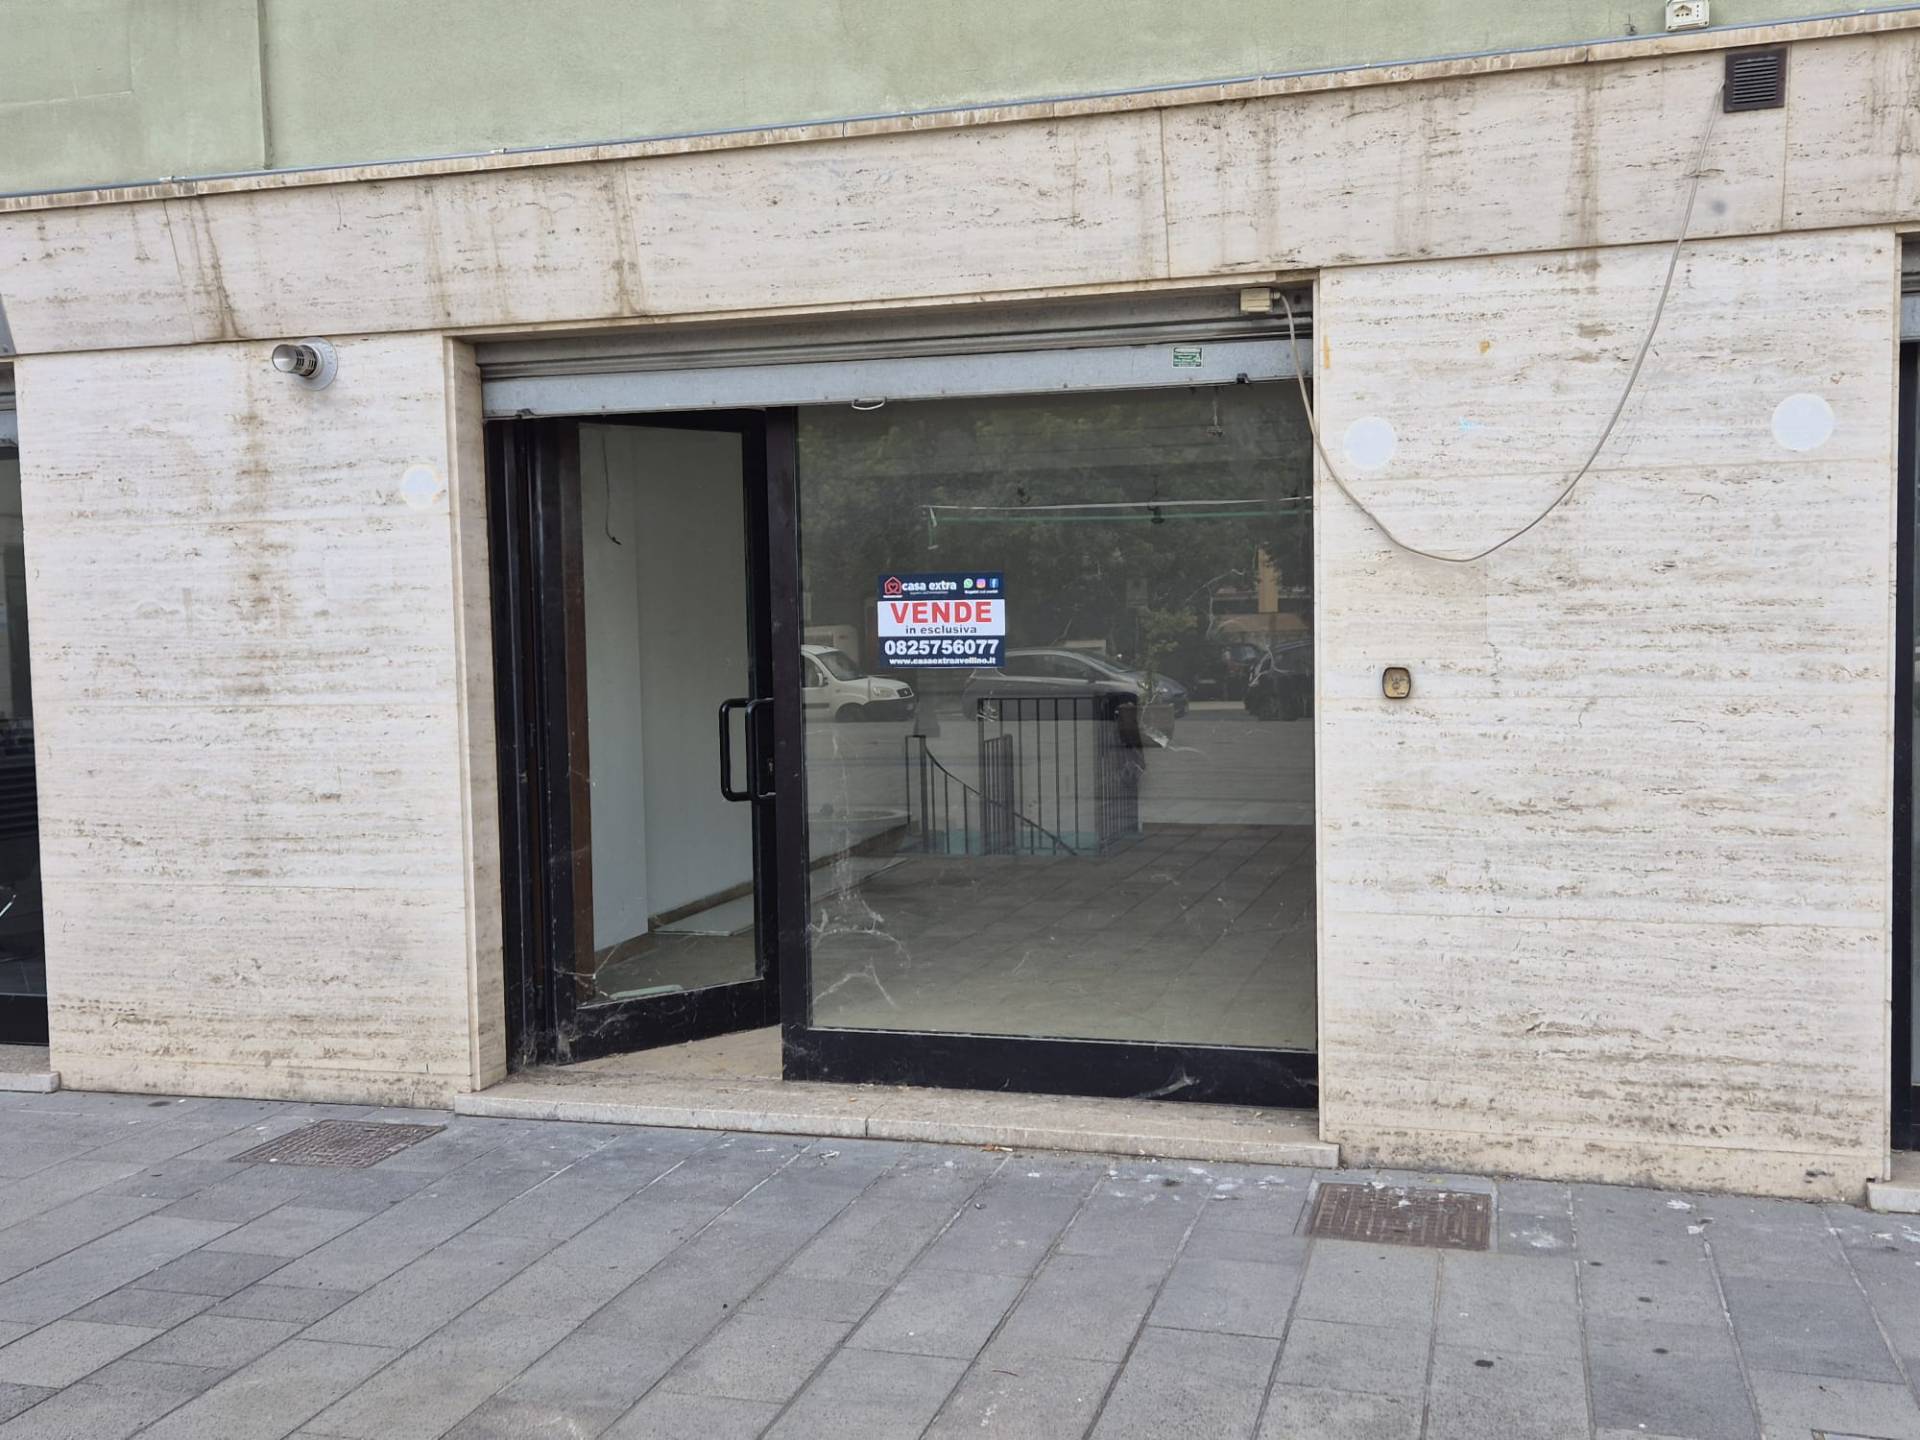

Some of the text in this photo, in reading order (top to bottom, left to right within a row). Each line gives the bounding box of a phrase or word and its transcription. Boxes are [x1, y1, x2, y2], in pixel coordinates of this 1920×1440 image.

[901, 580, 957, 591] casa extra
[890, 601, 992, 624] VENDE
[905, 625, 977, 634] in esclusiva
[884, 639, 999, 655] 0825756077
